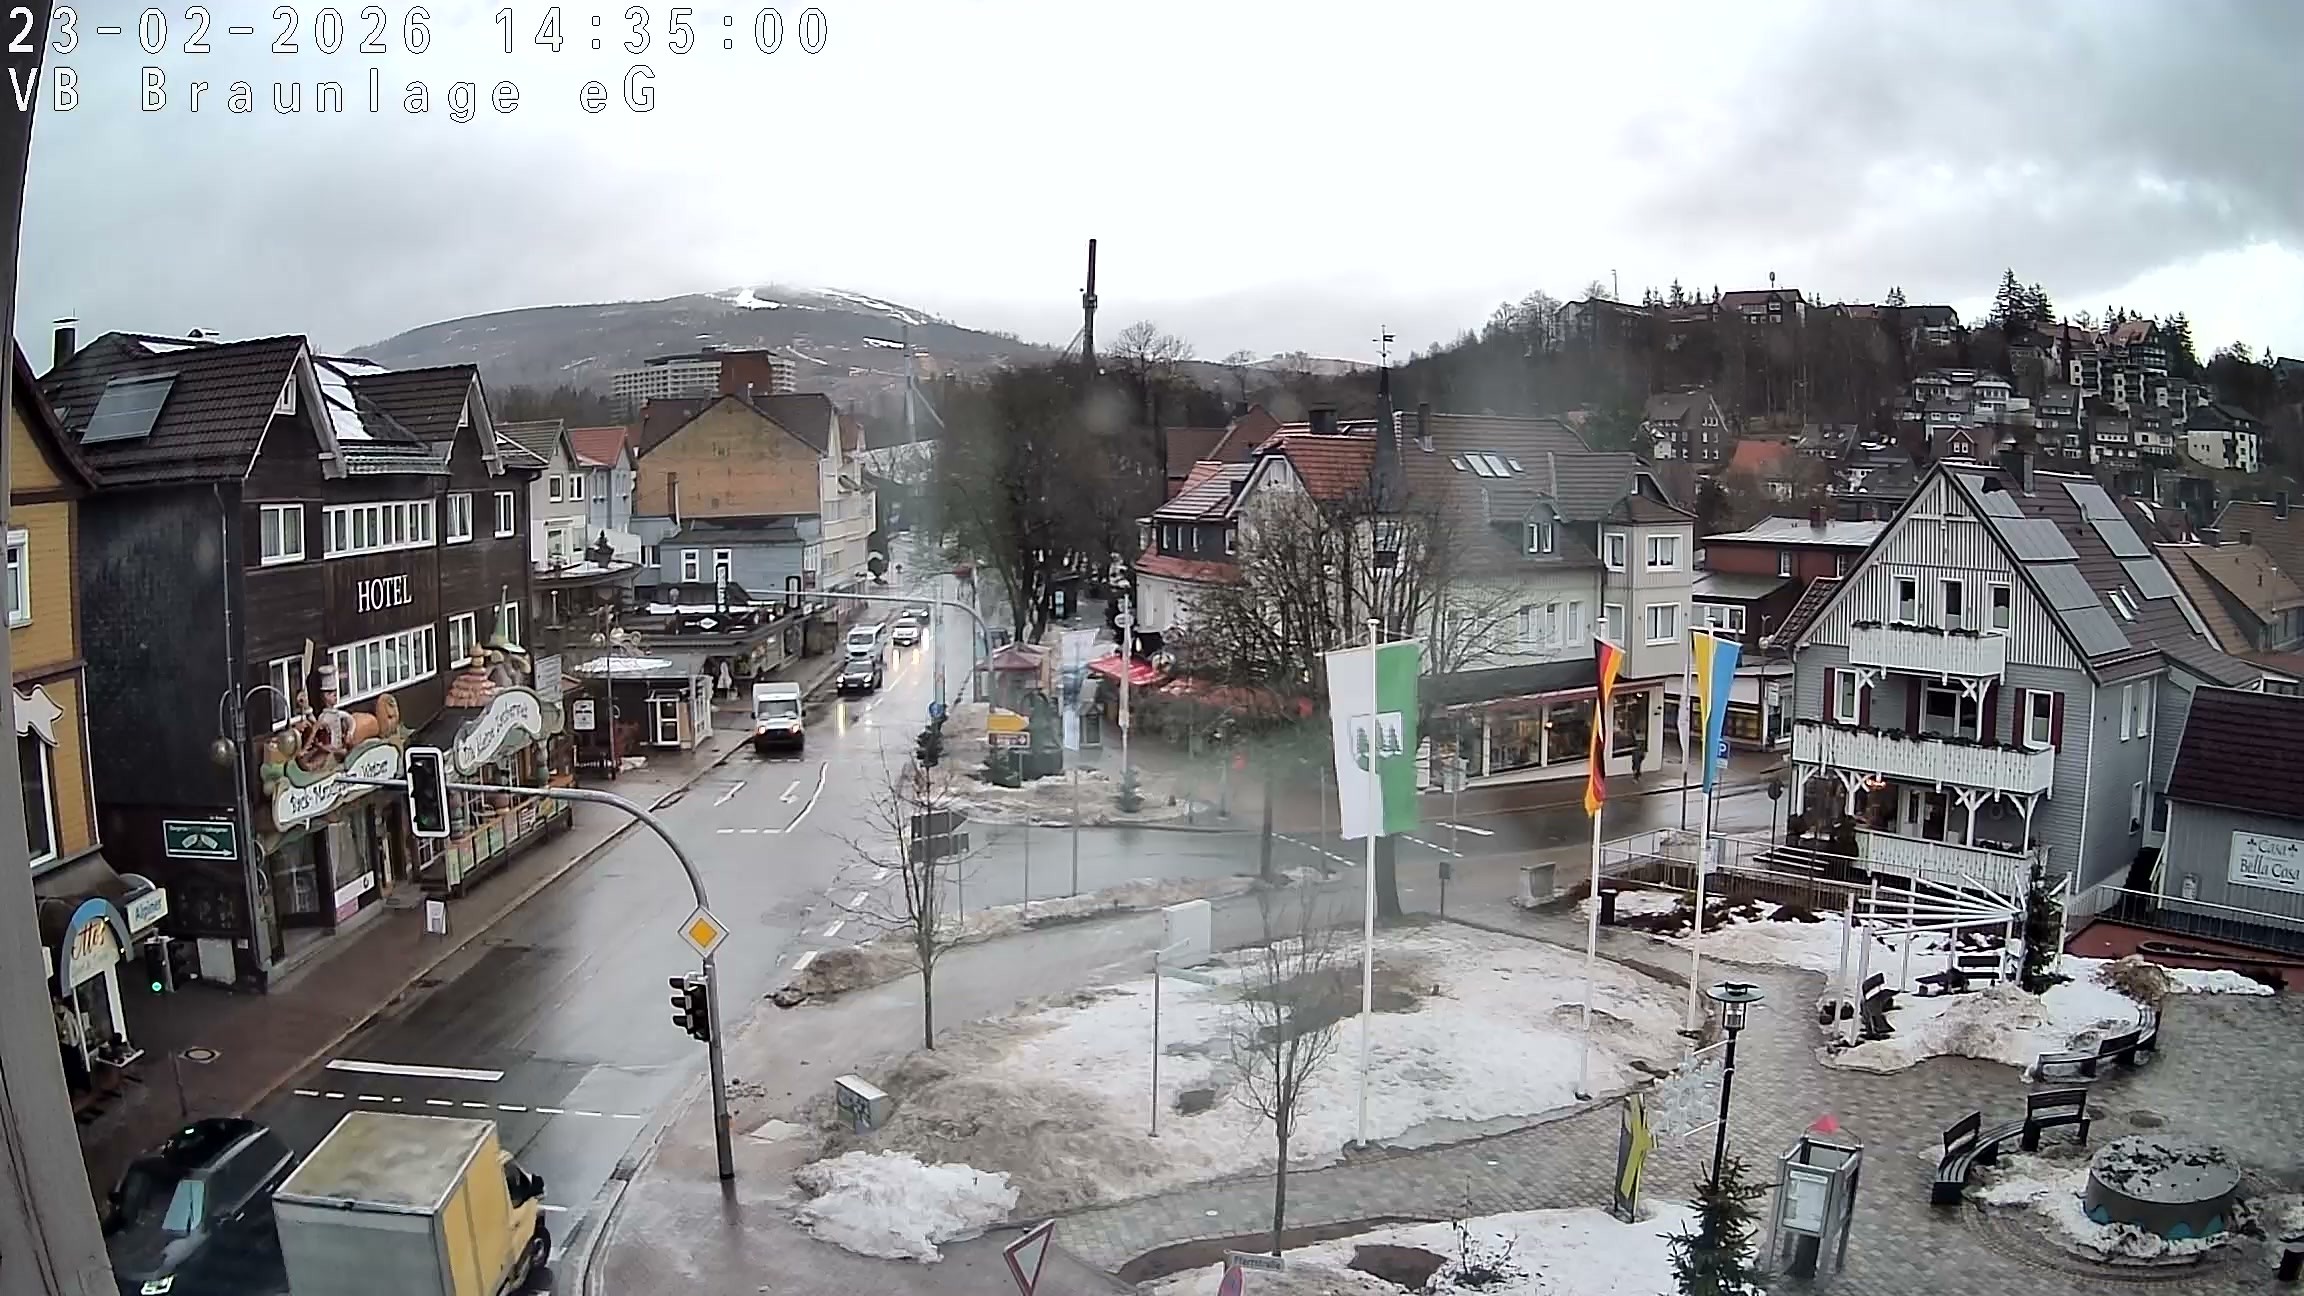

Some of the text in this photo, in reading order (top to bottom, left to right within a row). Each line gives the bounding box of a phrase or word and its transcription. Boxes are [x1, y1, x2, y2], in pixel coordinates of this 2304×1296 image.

[357, 574, 412, 613] HOTEL
[2258, 839, 2287, 856] Casa
[2240, 854, 2300, 880] Bella Casa
